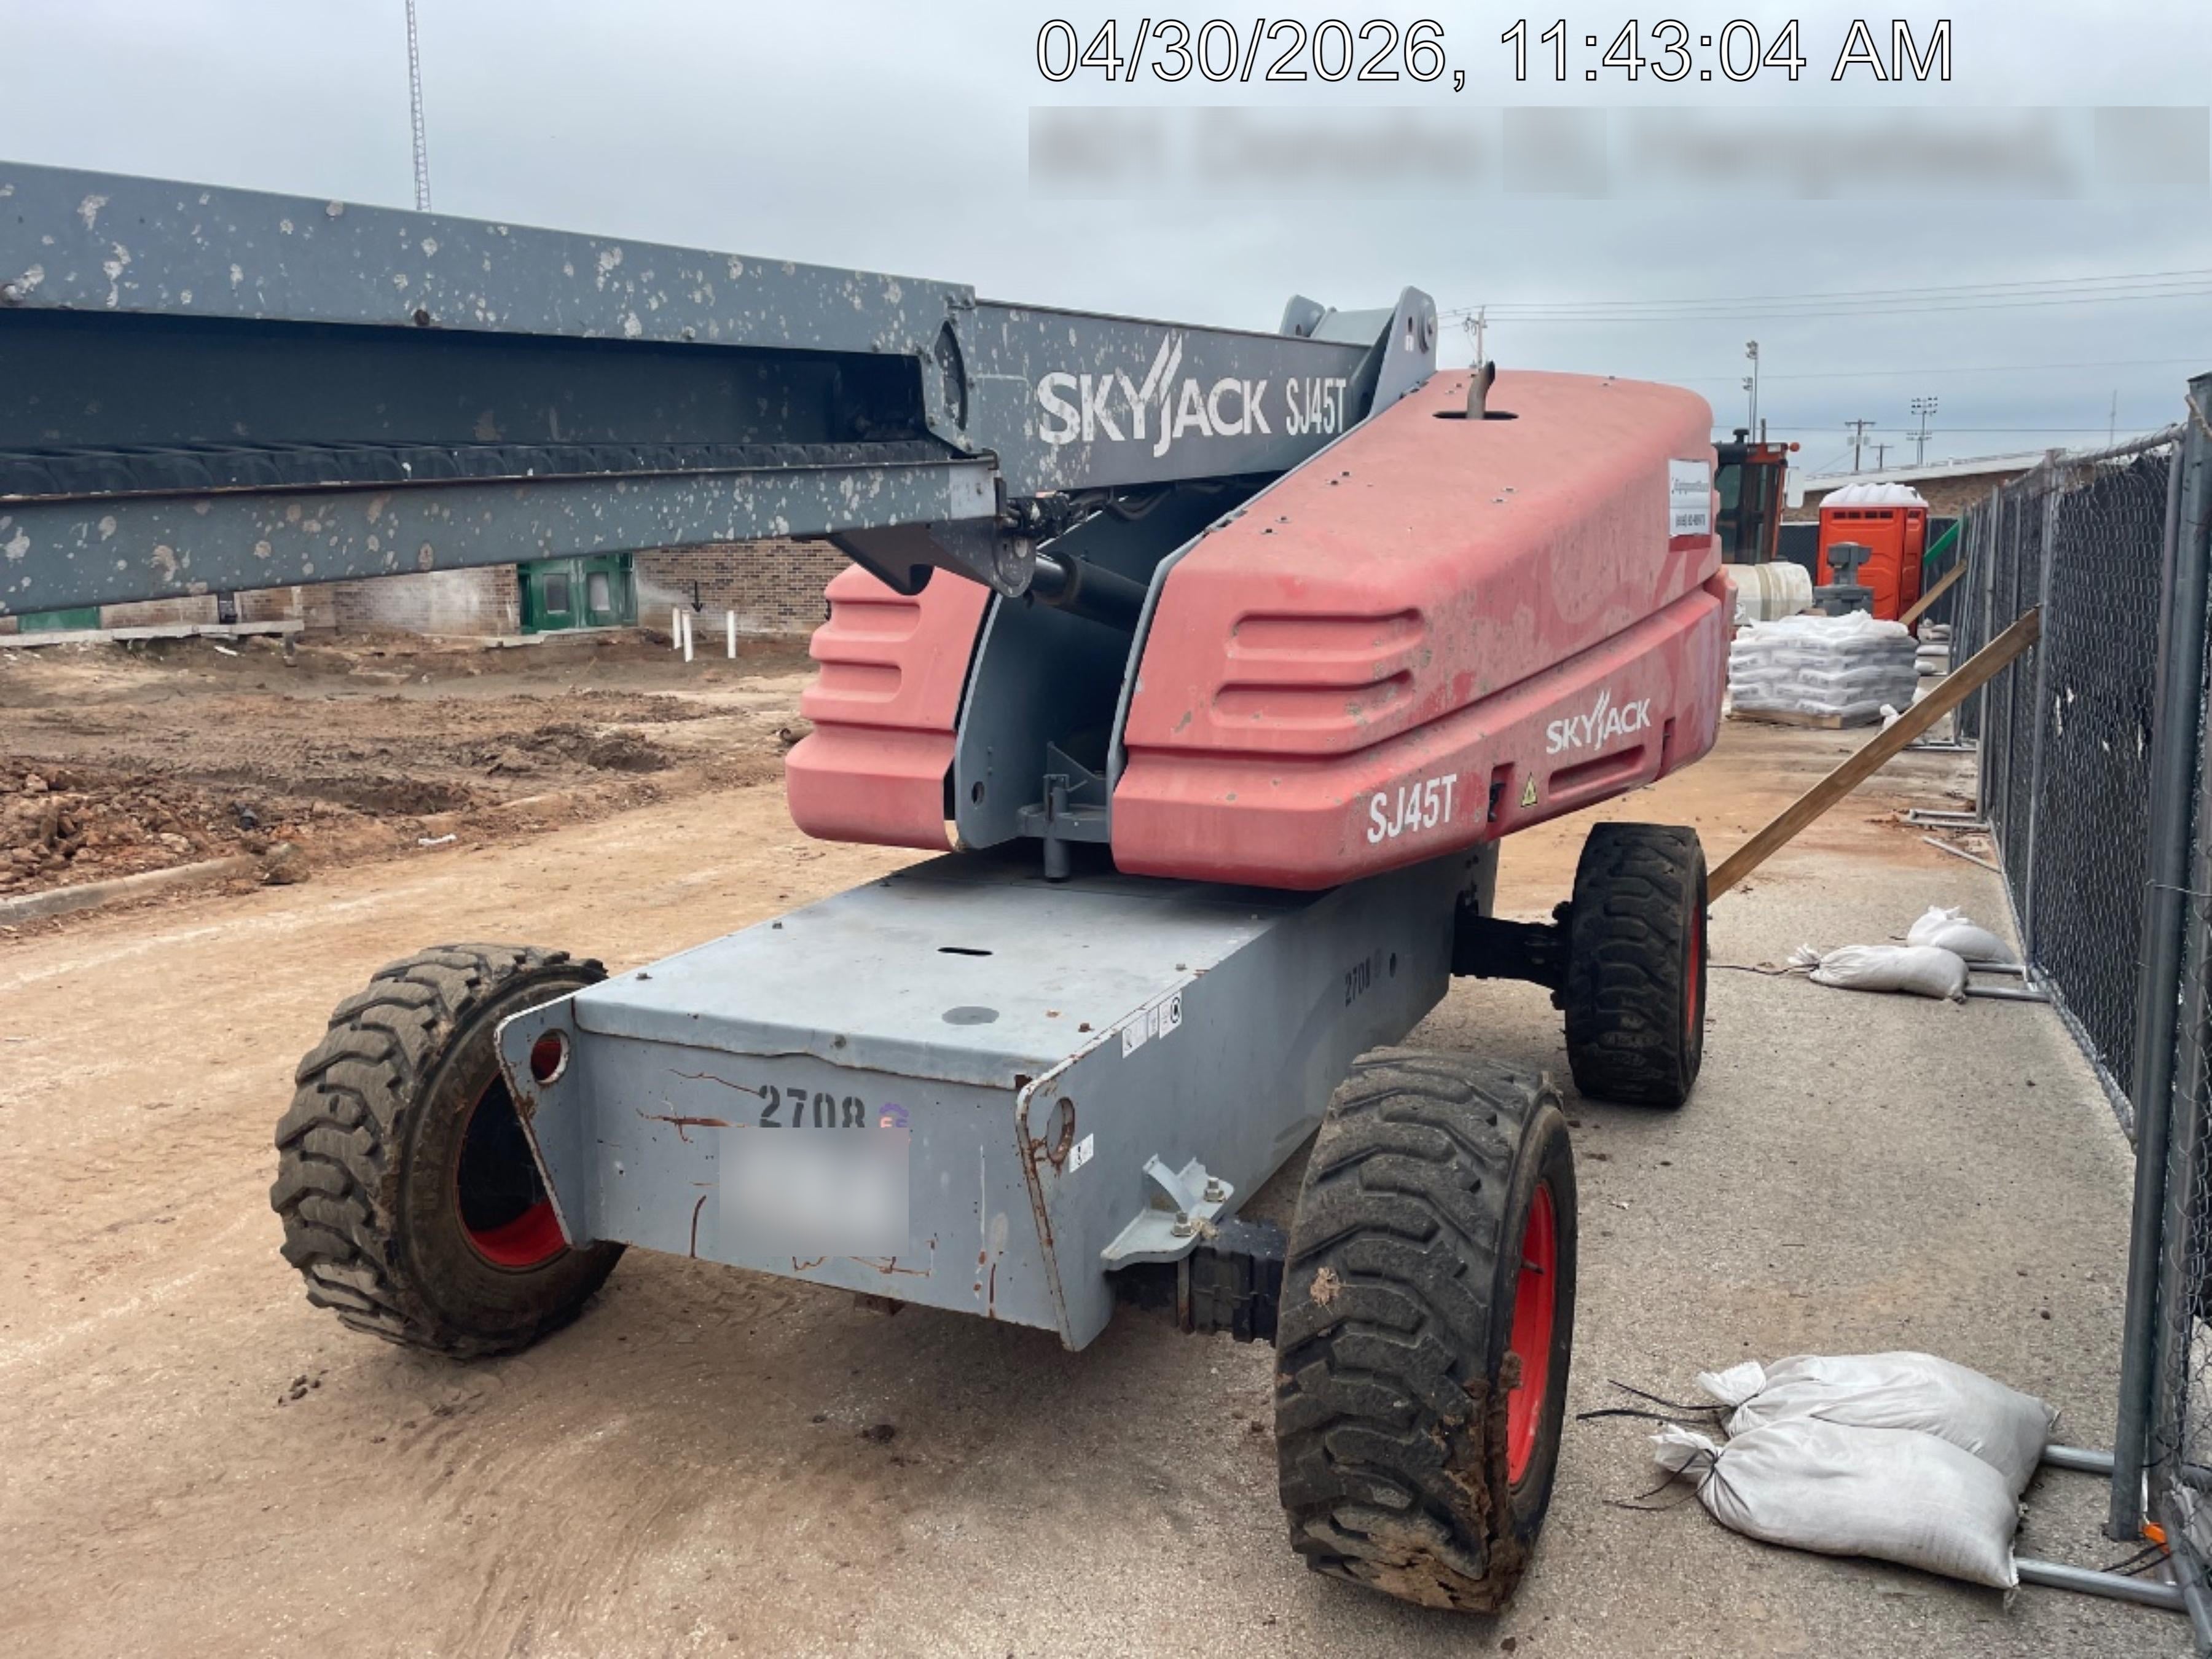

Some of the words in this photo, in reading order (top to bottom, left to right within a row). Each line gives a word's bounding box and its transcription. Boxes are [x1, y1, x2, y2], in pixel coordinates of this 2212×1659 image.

[1037, 332, 1271, 458] SKYJACK
[1285, 377, 1347, 435] SJ45T
[1546, 688, 1651, 755] SKYJACK
[1367, 774, 1457, 844] SJ45T
[758, 1084, 865, 1128] 2708
